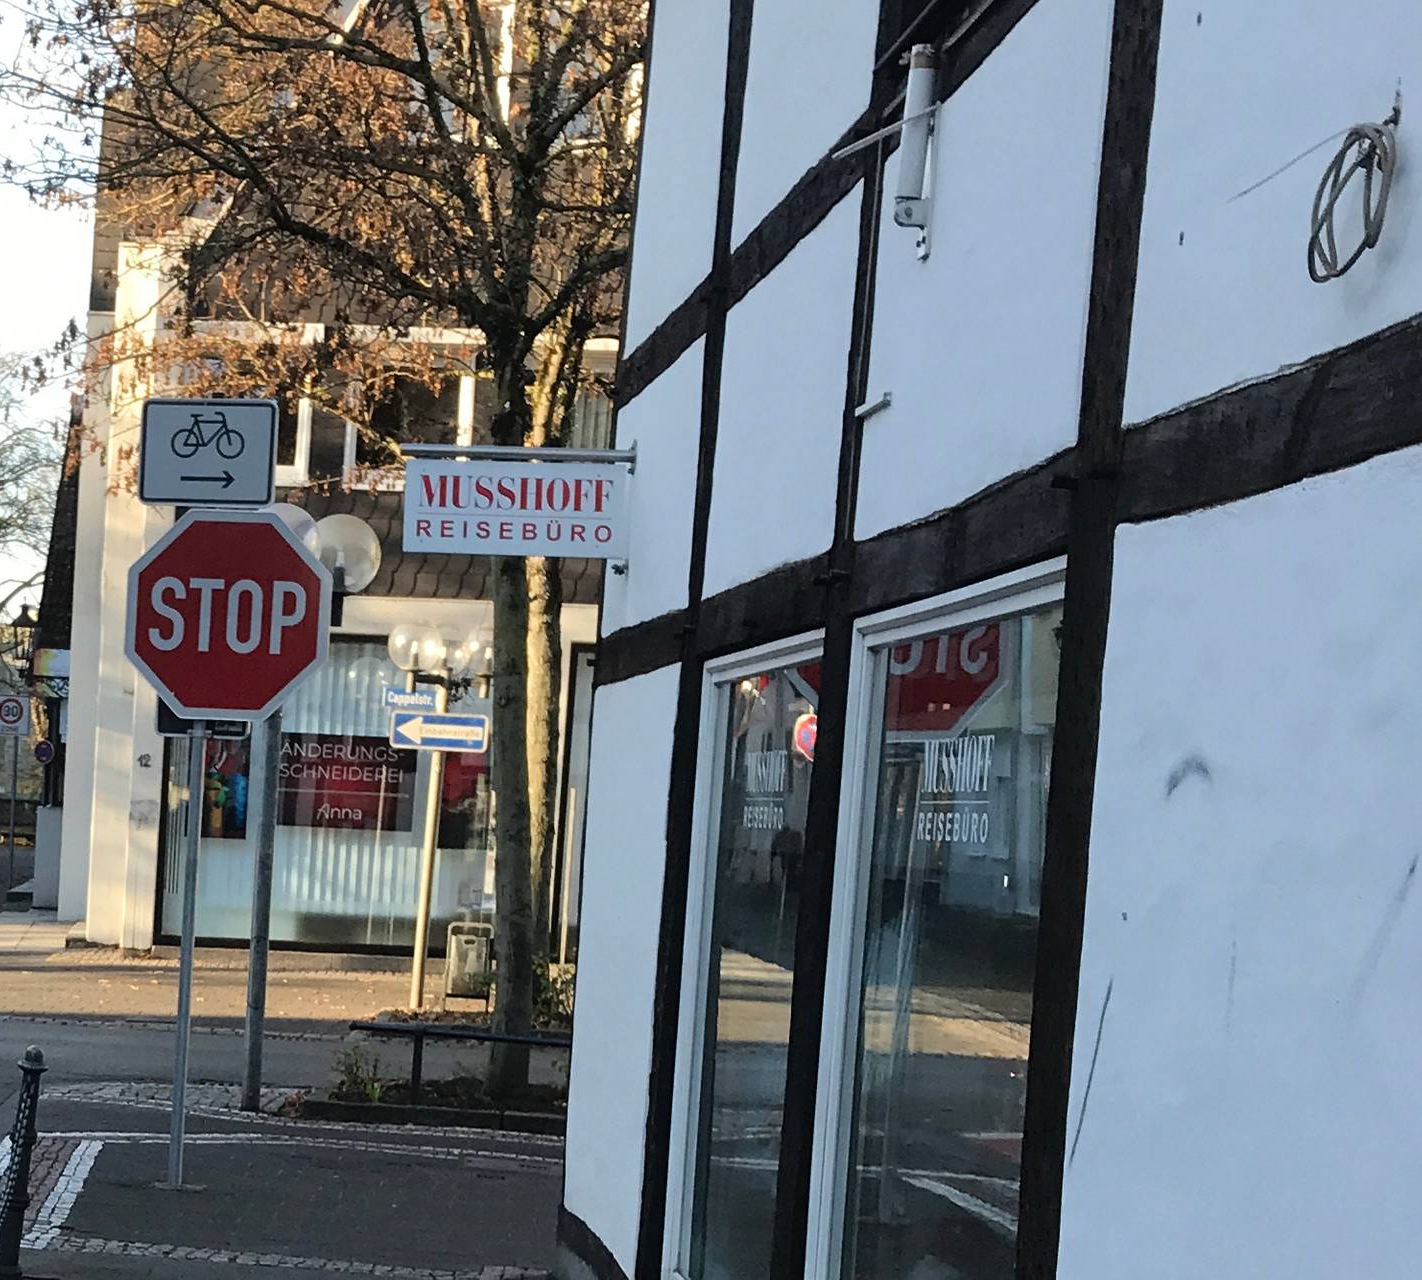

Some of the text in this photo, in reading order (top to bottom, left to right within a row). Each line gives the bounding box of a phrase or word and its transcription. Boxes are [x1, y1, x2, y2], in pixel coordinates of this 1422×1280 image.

[418, 474, 614, 513] MUSSHOFF
[416, 519, 613, 543] REISEBÜRO
[148, 576, 307, 655] STOP
[387, 690, 434, 707] Cappelstr.
[3, 705, 18, 718] 30
[138, 753, 151, 768] 12
[280, 738, 405, 762] ÄNDERUNGS-
[316, 803, 363, 820] Anna
[917, 807, 989, 843] REISEBÜRO
